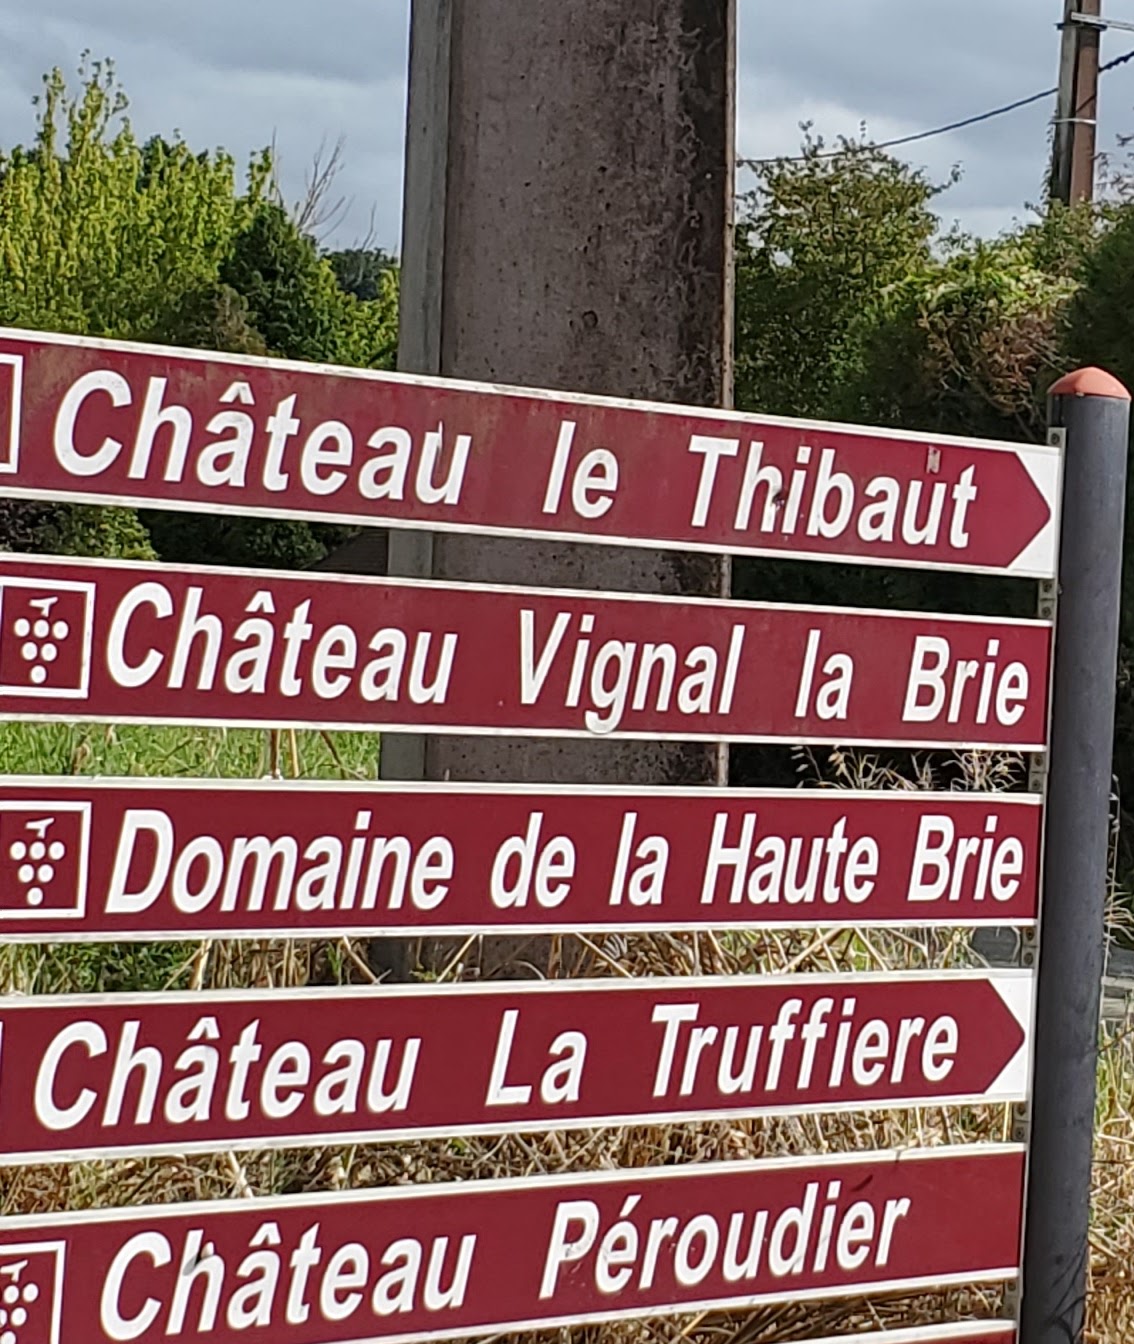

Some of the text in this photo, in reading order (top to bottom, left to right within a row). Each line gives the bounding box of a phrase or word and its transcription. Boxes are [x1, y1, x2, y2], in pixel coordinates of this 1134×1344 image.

[53, 369, 978, 549] Château le Thibaut
[106, 581, 1029, 734] Château Vignal la Brie
[104, 809, 1024, 914] Domaine de la Haute Brie
[34, 997, 959, 1131] Château La Truffiere
[100, 1180, 911, 1341] Château Péroudier
